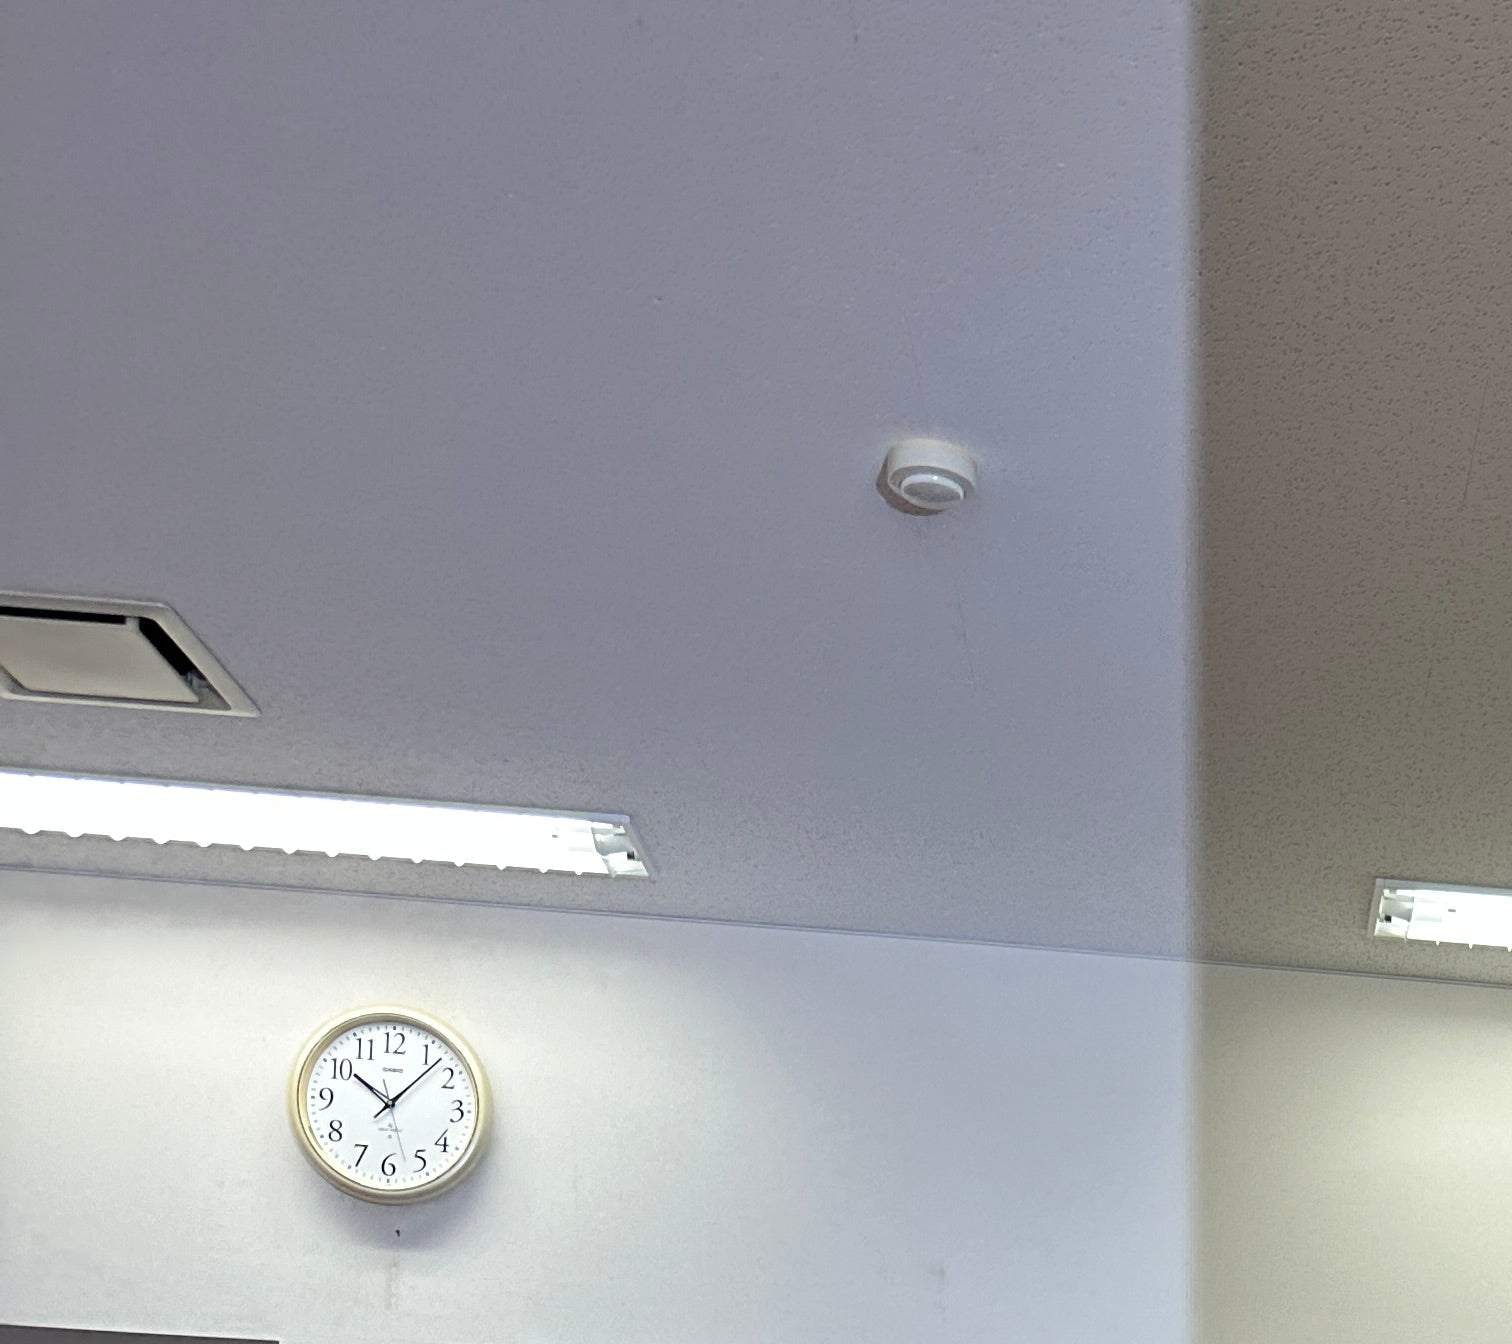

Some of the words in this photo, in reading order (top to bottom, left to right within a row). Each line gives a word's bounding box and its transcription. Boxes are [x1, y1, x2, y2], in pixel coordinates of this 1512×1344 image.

[356, 1038, 375, 1061] 11
[383, 1032, 406, 1055] 12
[422, 1044, 430, 1066] 1
[331, 1058, 353, 1081] 10
[441, 1067, 455, 1090] 2
[319, 1088, 334, 1111] 9
[449, 1099, 464, 1123] 3
[328, 1119, 343, 1142] 8
[434, 1129, 449, 1153] 4
[353, 1143, 369, 1167] 7
[381, 1153, 397, 1177] 6
[412, 1149, 427, 1173] 5
